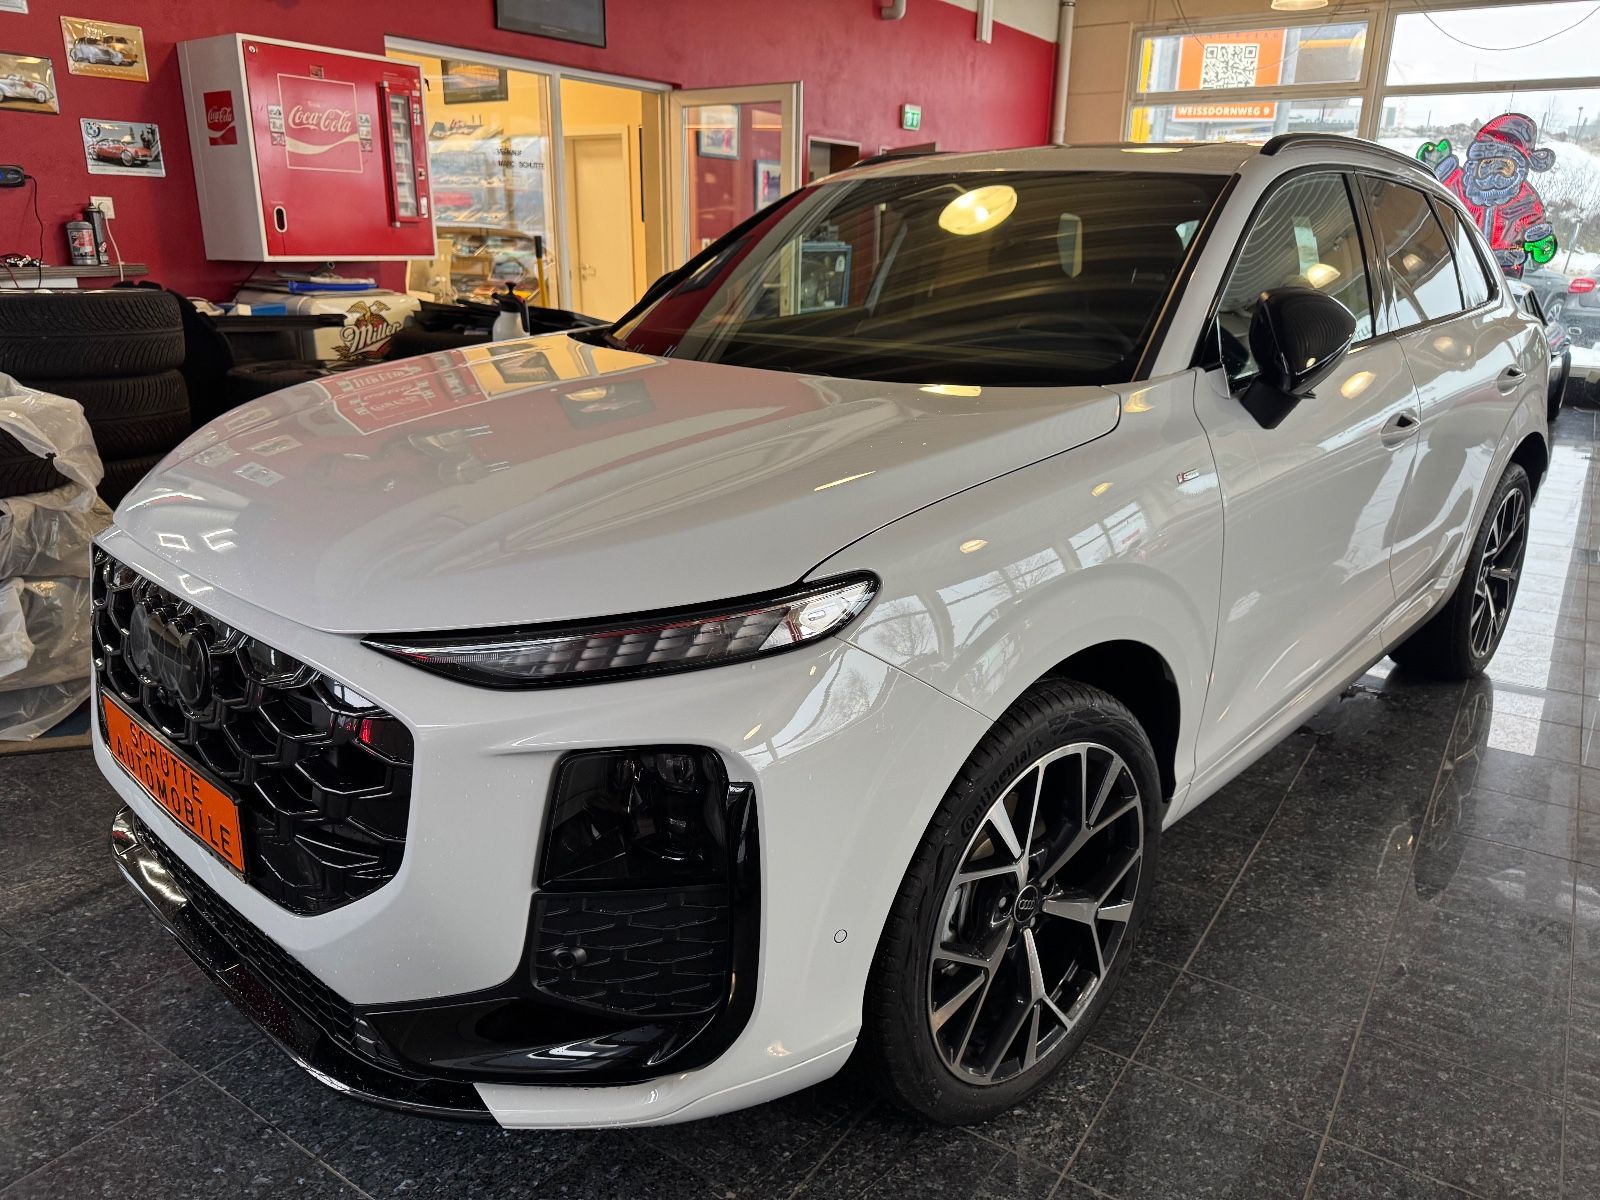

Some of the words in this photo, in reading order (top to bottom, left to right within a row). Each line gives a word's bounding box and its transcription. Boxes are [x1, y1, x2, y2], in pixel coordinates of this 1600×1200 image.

[288, 105, 352, 132] Coca-Cola
[1178, 106, 1261, 116] WEISSDORNWEG
[1263, 106, 1270, 115] 9
[340, 322, 403, 353] Miller
[117, 735, 233, 859] AUTOMOBILE
[960, 741, 1031, 838] Continental
